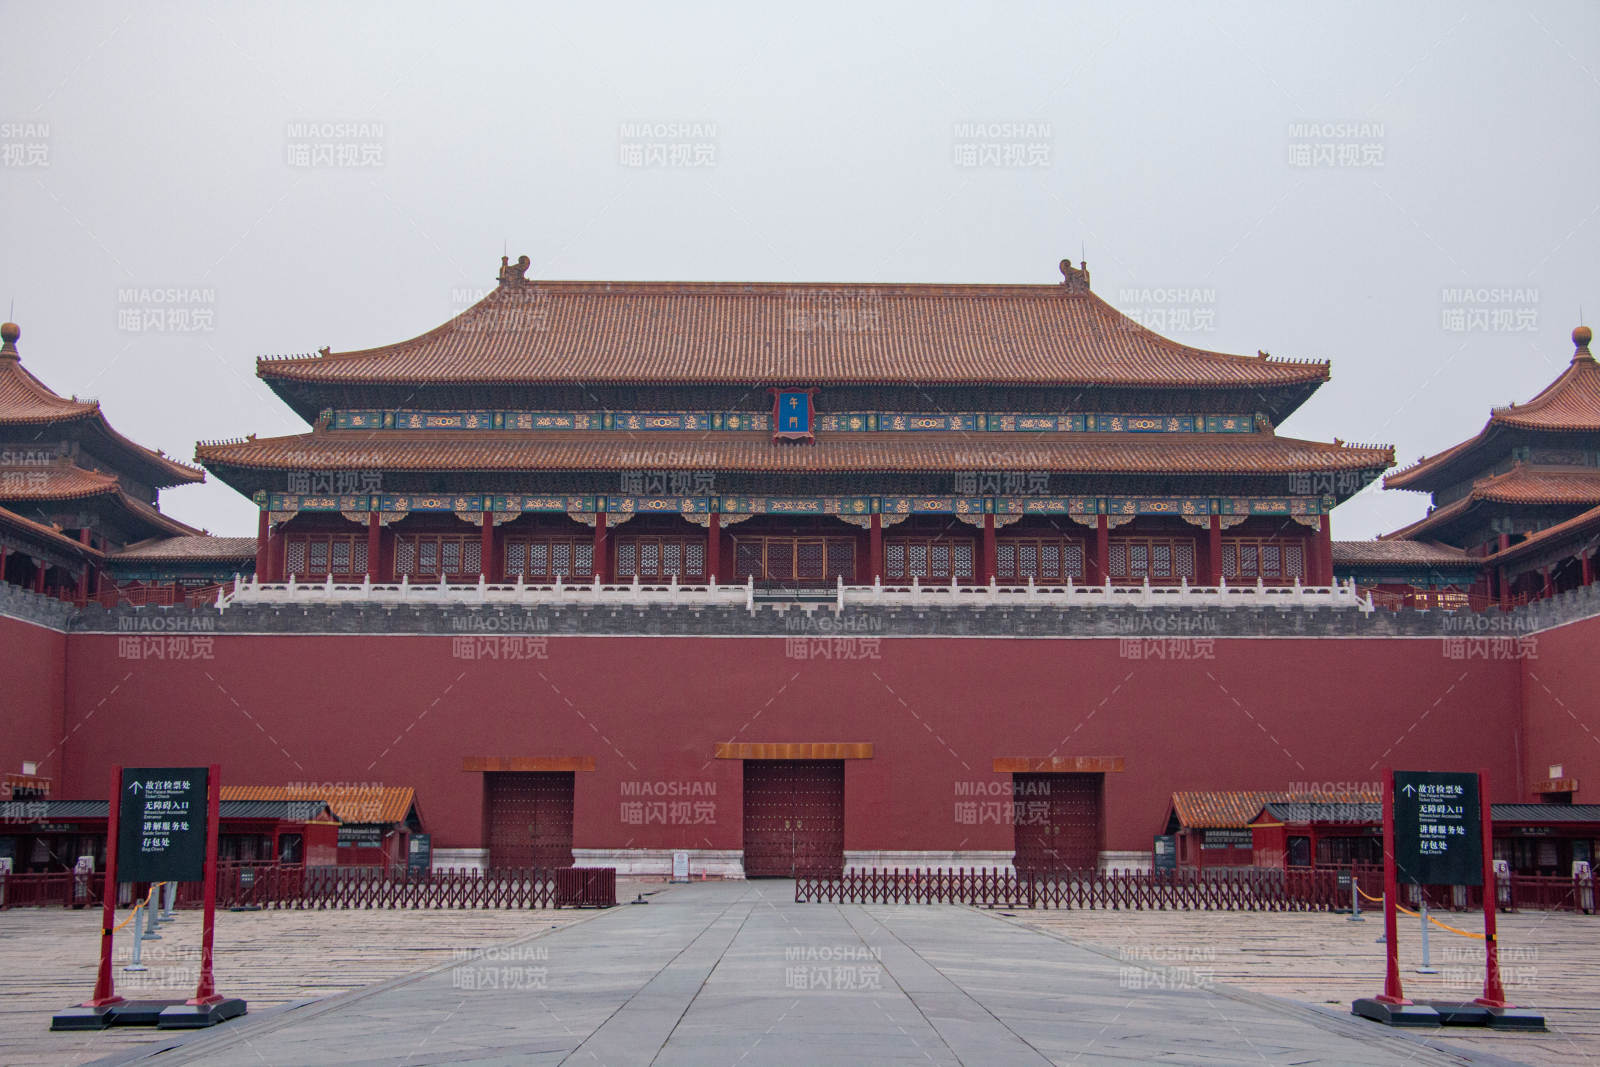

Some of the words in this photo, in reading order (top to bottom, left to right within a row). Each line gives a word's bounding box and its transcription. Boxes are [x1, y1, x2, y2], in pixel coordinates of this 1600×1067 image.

[145, 780, 191, 790] 故宫检票处
[1418, 784, 1464, 794] 故宫检票处
[144, 801, 189, 810] 无障碍入口
[1419, 805, 1464, 814] 无障碍入口
[143, 821, 190, 831] 讲解服务处
[1420, 825, 1465, 834] 讲解服务处
[143, 837, 170, 847] 存包处
[1420, 840, 1447, 850] 存包处
